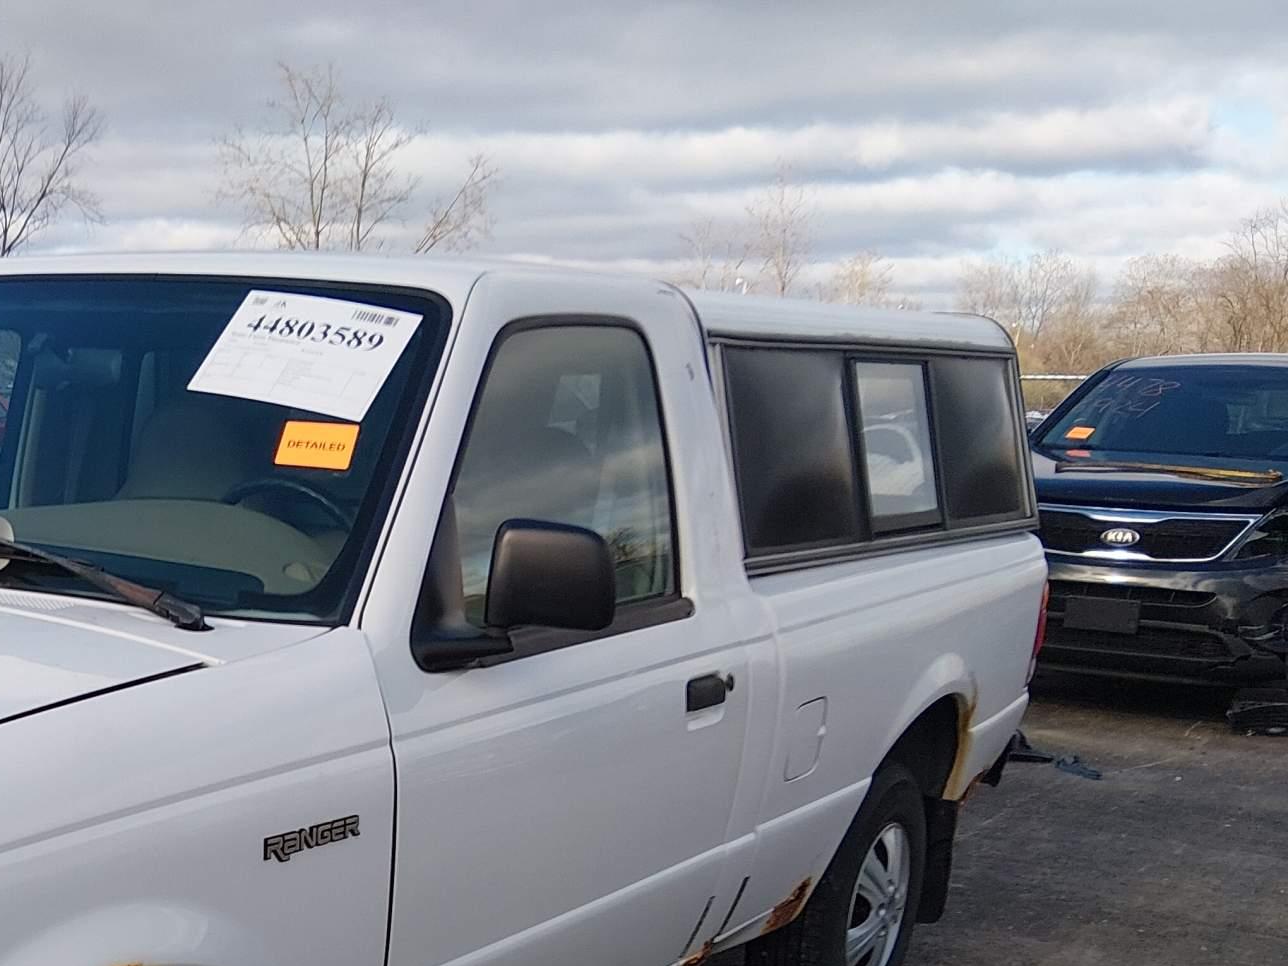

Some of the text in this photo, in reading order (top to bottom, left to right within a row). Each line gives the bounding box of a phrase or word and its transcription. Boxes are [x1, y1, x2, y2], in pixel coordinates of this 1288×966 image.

[247, 313, 386, 352] 44803589
[287, 438, 347, 453] DETAILED
[1106, 531, 1133, 543] KIA
[262, 814, 361, 863] RANGER
